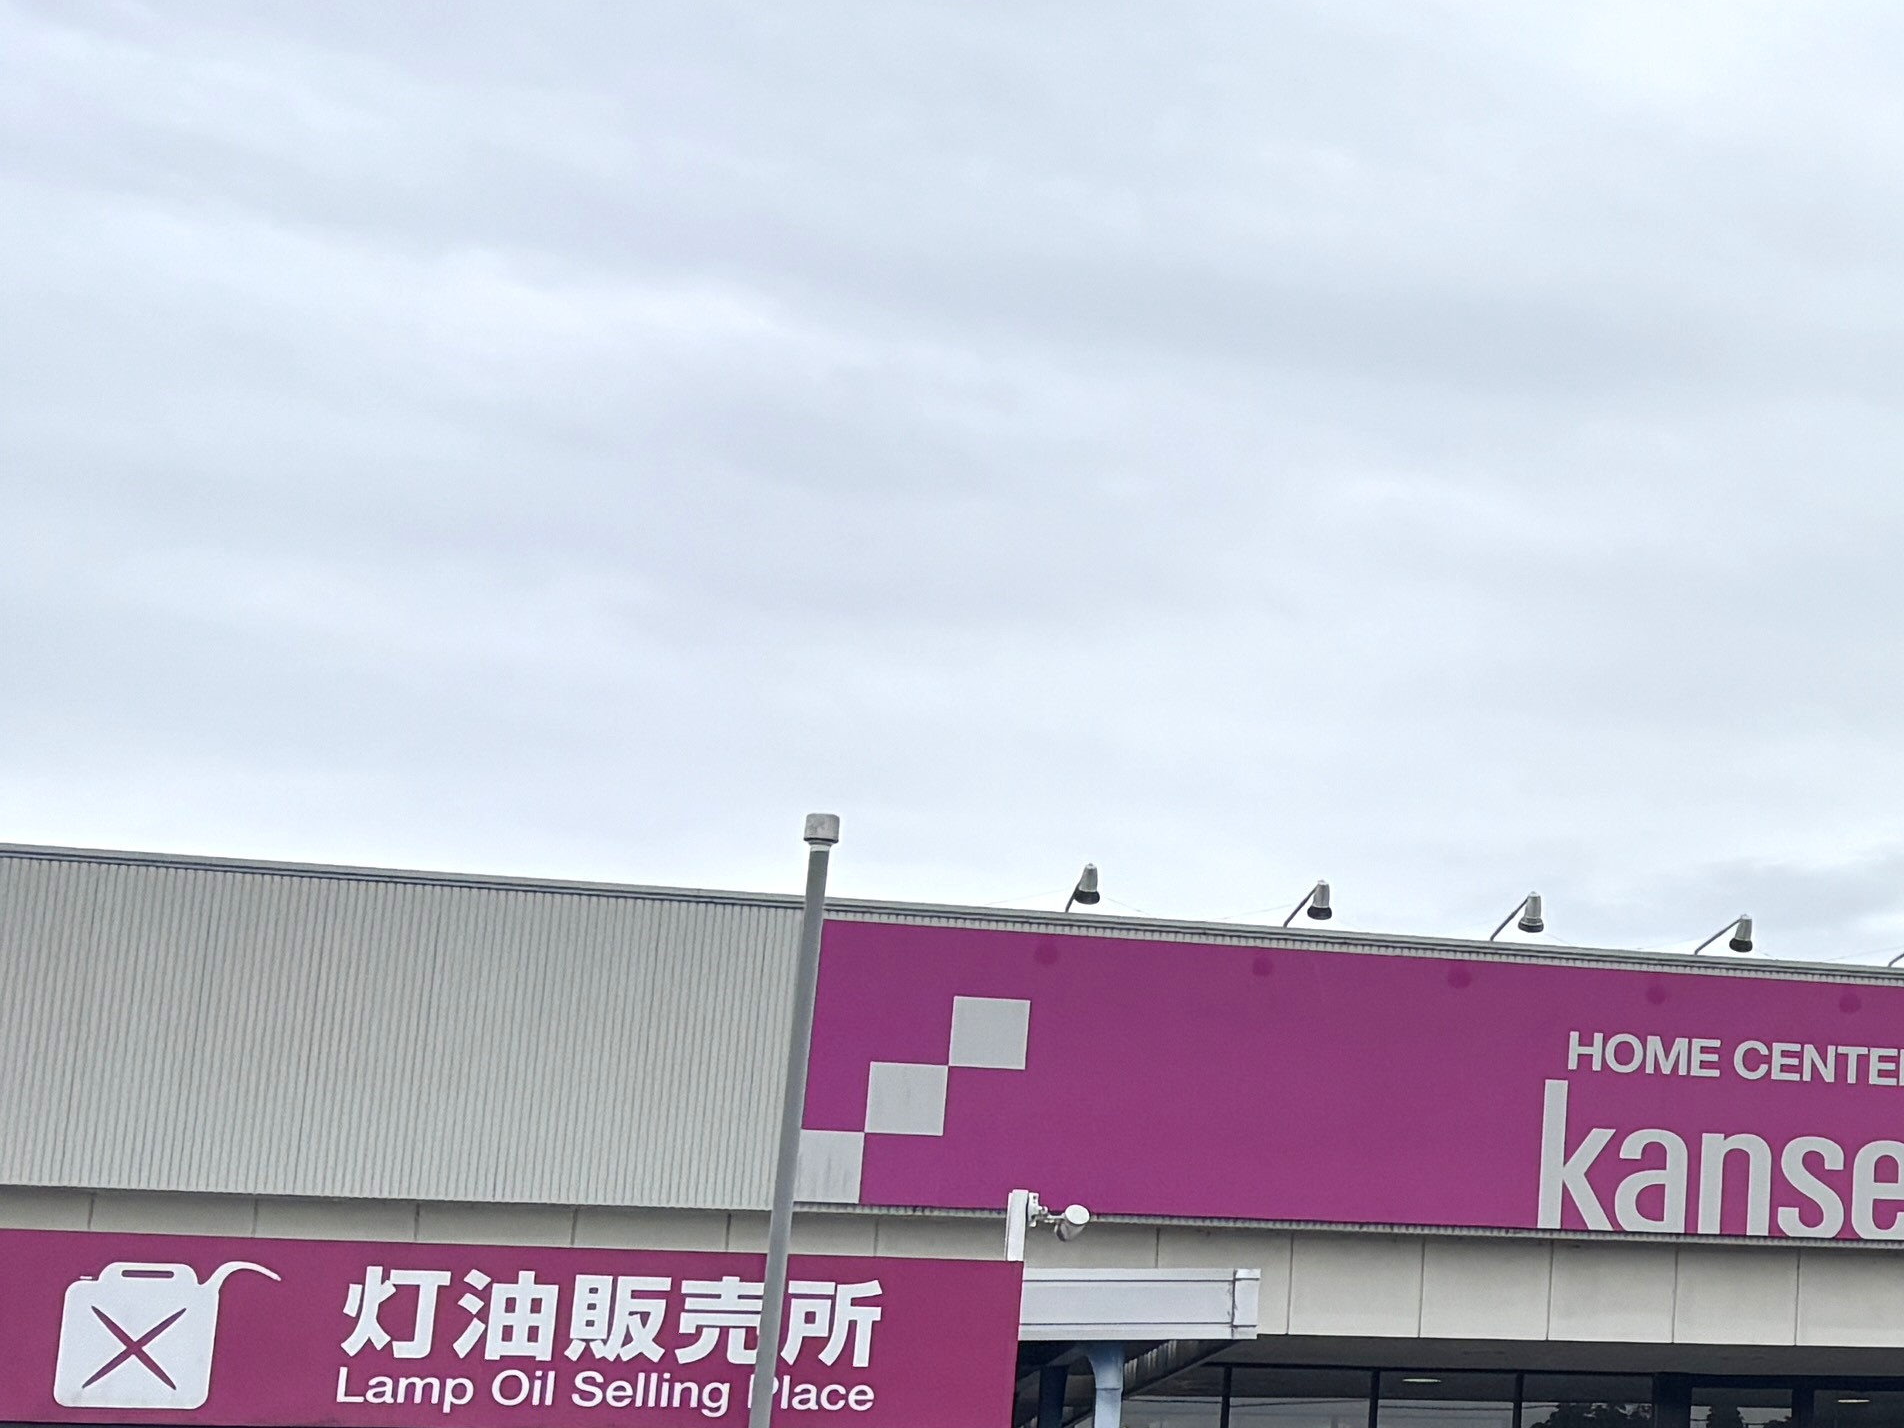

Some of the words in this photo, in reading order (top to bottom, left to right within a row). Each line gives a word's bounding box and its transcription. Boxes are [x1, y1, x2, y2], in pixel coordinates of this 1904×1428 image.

[1567, 1030, 1721, 1077] HOME
[340, 1265, 883, 1368] 灯油販売所
[335, 1366, 475, 1414] Lamp
[491, 1369, 556, 1409] Oil
[571, 1371, 730, 1418] Selling
[749, 1375, 876, 1412] lace
